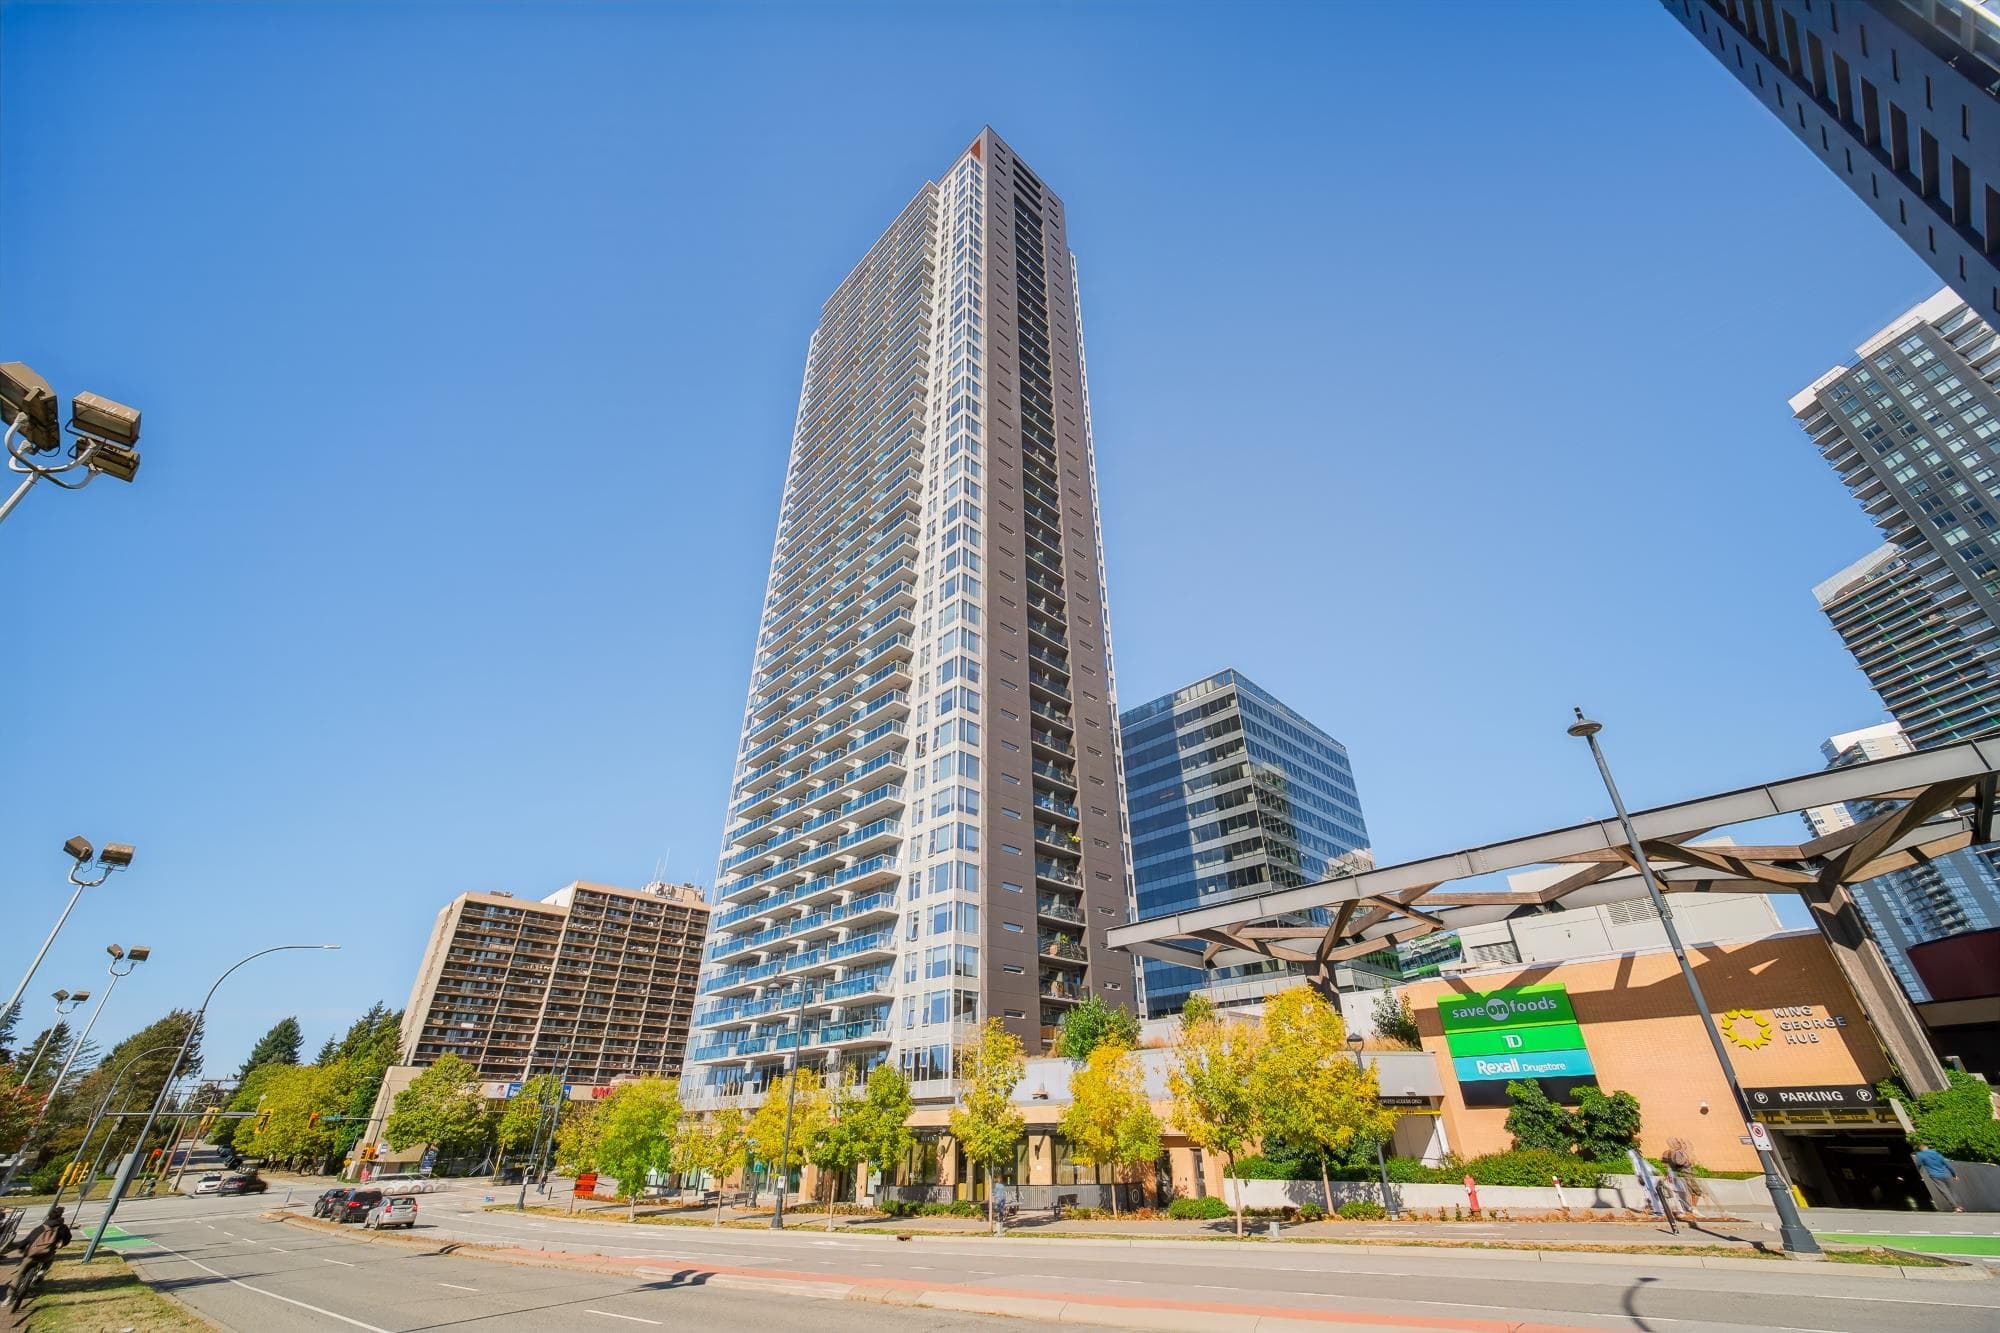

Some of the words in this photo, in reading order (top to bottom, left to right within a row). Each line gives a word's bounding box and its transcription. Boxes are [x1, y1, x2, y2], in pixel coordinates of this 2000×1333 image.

[1452, 1006, 1485, 1018] save
[1509, 997, 1557, 1013] foods
[1772, 1005, 1813, 1018] KING
[1780, 1016, 1847, 1031] GEORGE
[1502, 1034, 1522, 1048] TD
[1785, 1032, 1819, 1044] HUB
[1476, 1058, 1521, 1075] Rexall
[1522, 1062, 1566, 1073] Drugstore
[1779, 1090, 1844, 1103] PARKING
